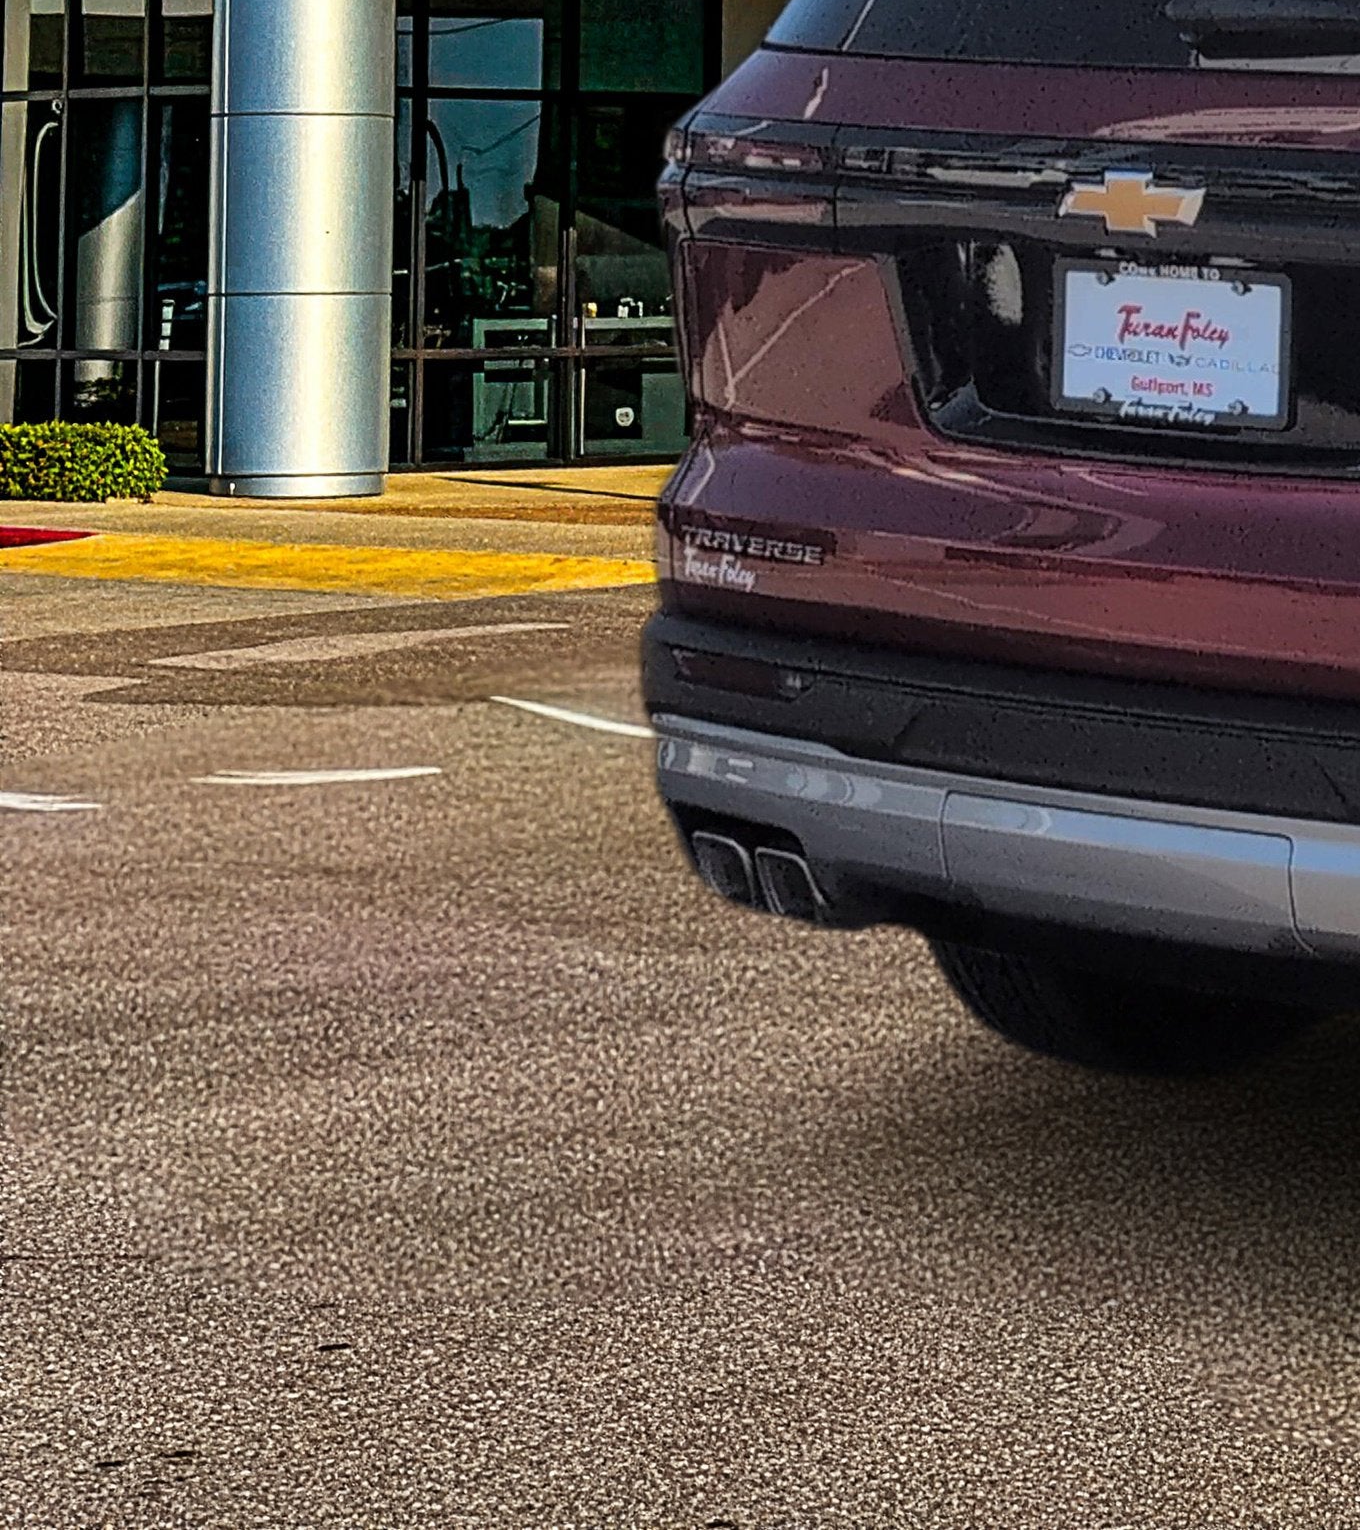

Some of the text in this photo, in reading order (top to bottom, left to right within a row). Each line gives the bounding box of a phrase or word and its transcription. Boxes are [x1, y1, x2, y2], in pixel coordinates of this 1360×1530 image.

[1159, 264, 1199, 280] HOME
[1201, 267, 1221, 281] TO
[1094, 345, 1160, 366] CHEVROLET
[1192, 380, 1215, 398] MS
[680, 523, 824, 566] TRAVERSE
